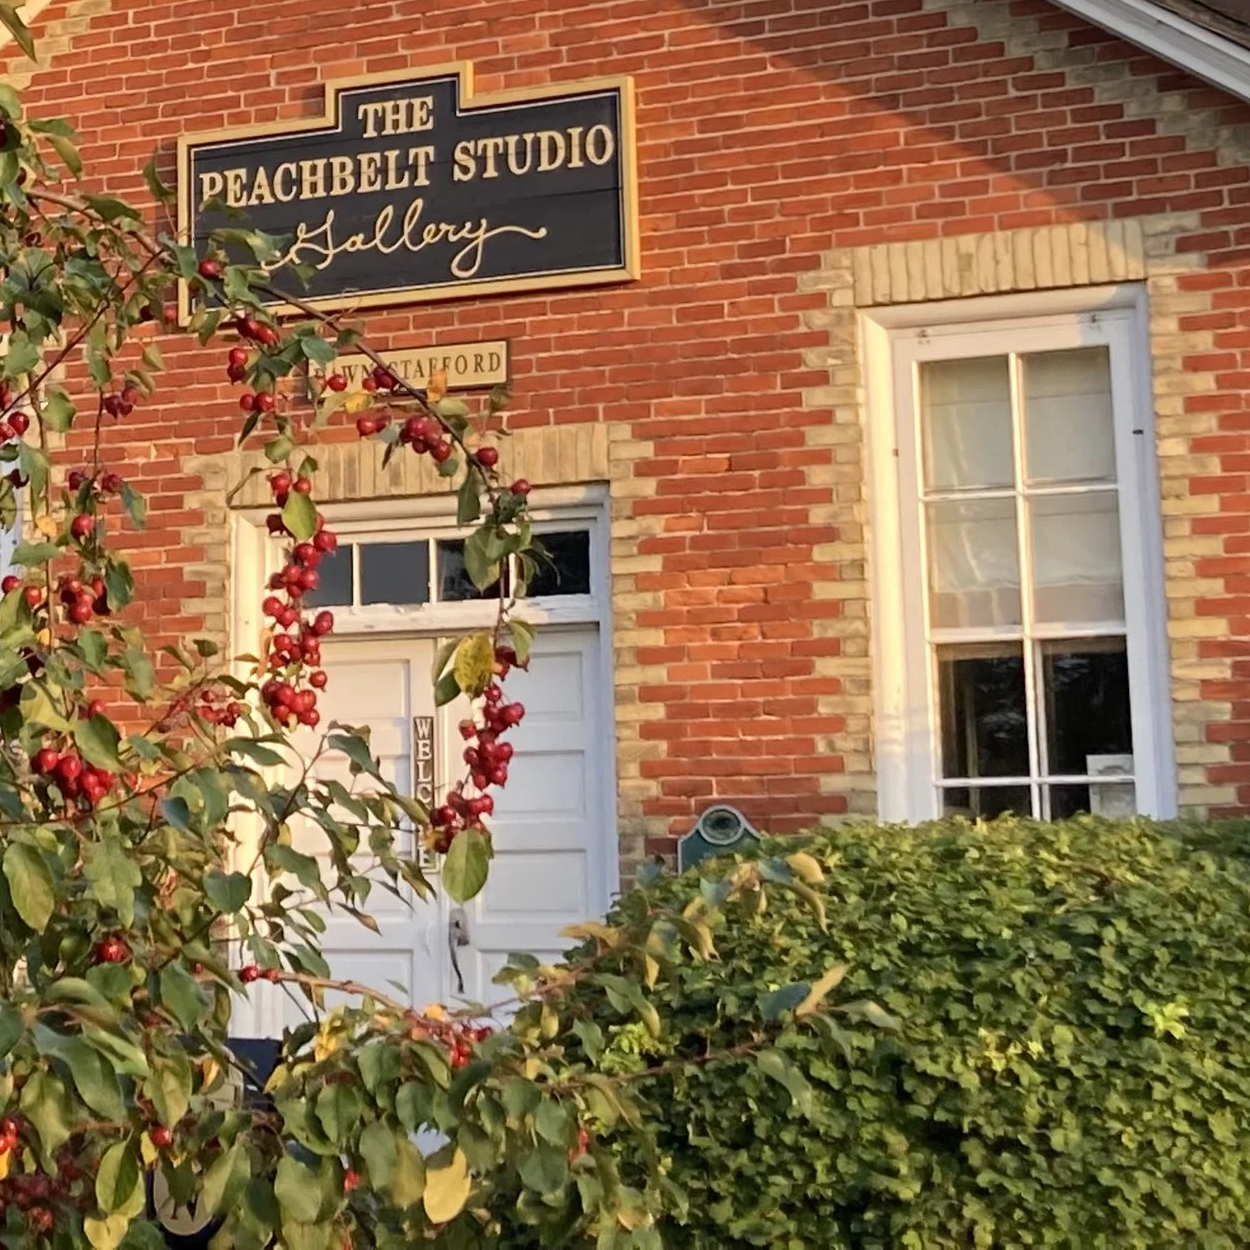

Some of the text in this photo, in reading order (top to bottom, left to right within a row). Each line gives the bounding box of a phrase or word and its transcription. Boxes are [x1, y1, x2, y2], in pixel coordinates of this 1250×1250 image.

[358, 95, 434, 139] THE
[199, 124, 615, 208] PEACHBELT STUDIO
[260, 197, 548, 278] Gallery
[415, 718, 435, 867] WELCE
